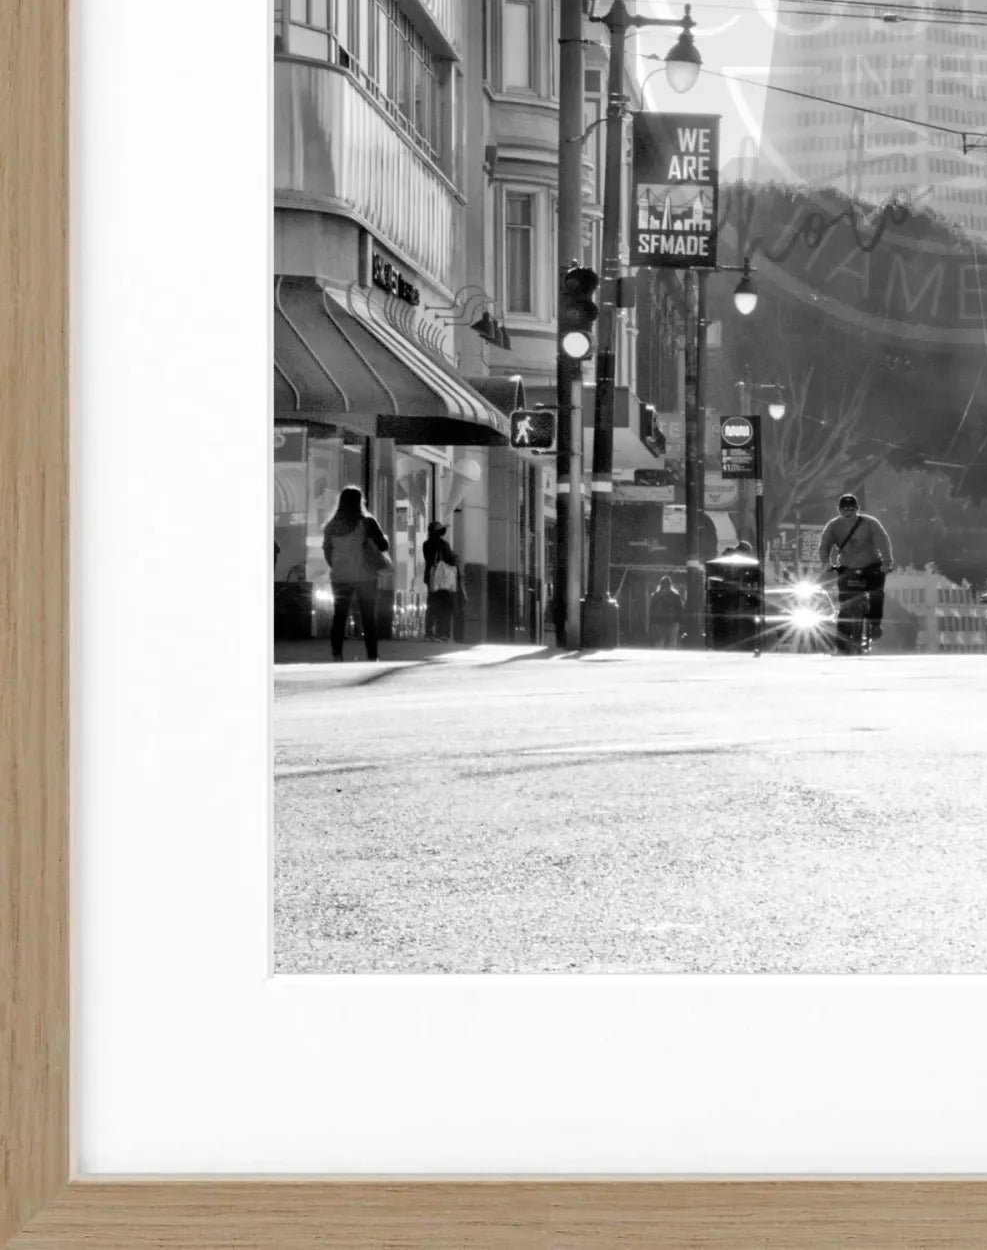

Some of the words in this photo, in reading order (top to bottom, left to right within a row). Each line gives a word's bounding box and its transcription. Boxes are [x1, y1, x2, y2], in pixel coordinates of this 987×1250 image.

[677, 128, 710, 153] WE
[667, 155, 710, 180] ARE
[638, 233, 709, 256] SFMADE
